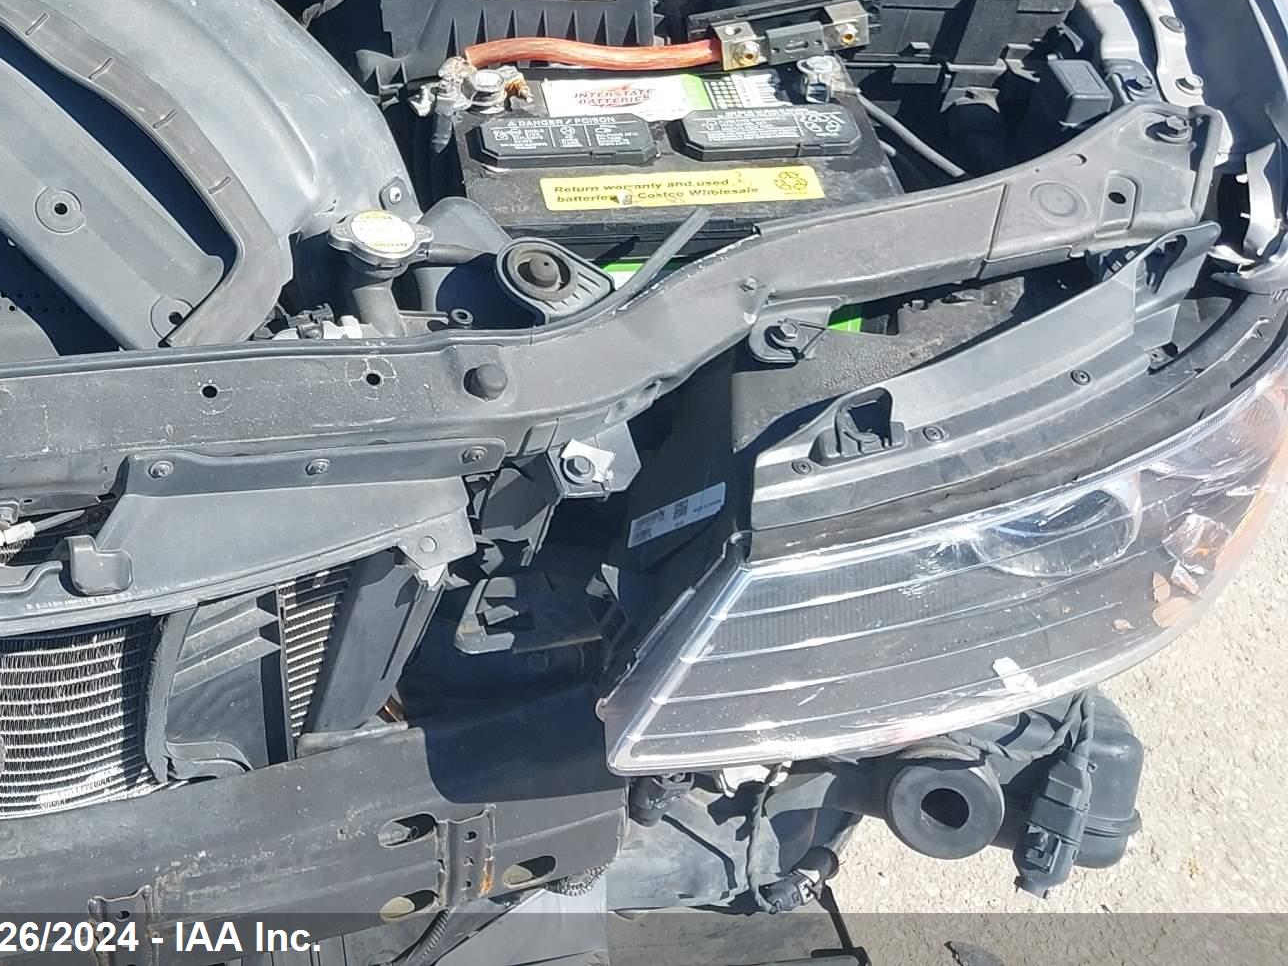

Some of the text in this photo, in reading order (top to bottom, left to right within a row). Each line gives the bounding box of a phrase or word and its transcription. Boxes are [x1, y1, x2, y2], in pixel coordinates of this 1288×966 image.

[574, 88, 652, 99] INTERSTATE
[578, 95, 650, 105] BATTERIES
[518, 119, 564, 127] DANGER
[574, 116, 616, 124] POISON
[554, 185, 599, 194] Return
[667, 180, 695, 188] and
[696, 179, 729, 187] used
[638, 190, 684, 200] Costco
